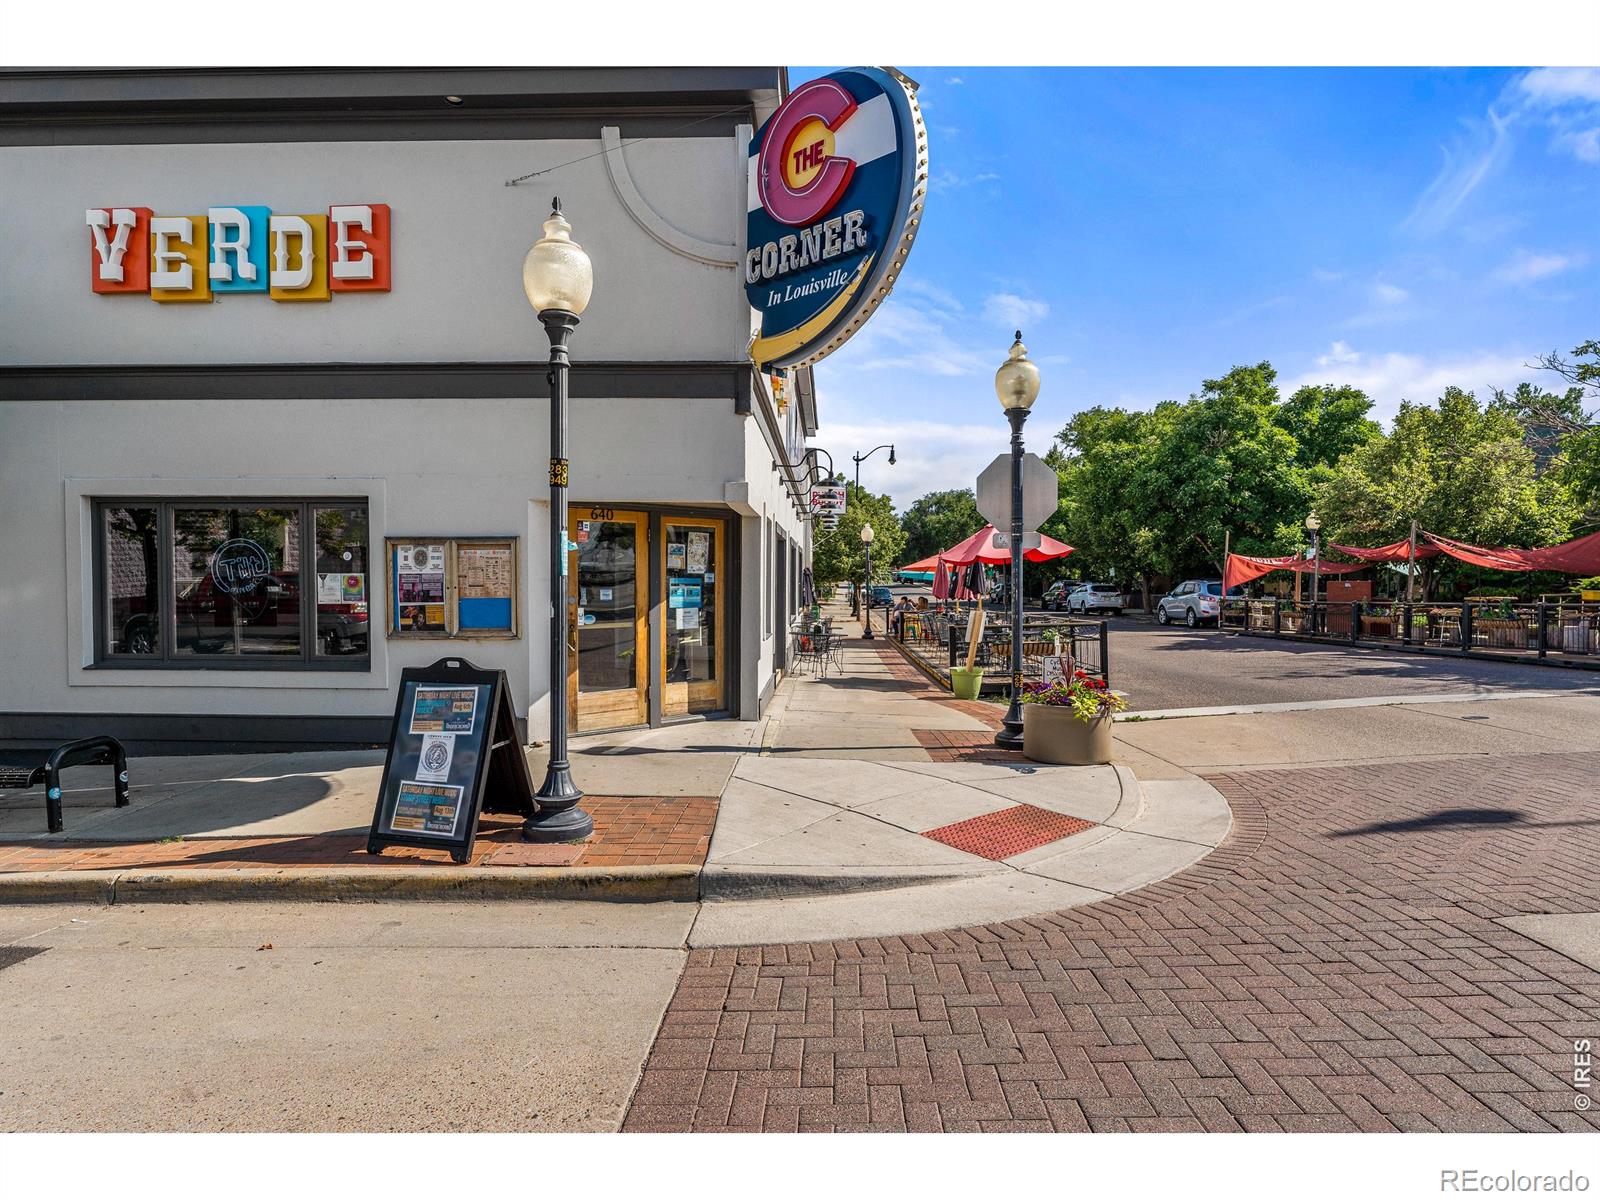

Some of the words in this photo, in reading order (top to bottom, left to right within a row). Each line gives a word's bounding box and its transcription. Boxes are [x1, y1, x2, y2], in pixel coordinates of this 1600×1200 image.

[793, 139, 826, 174] THE
[86, 205, 374, 290] VERDE
[745, 209, 869, 285] CORNER
[767, 290, 781, 307] In
[784, 268, 848, 302] Louisville
[591, 509, 614, 521] 640
[219, 556, 262, 582] Tilt
[451, 691, 462, 699] LIVE
[454, 703, 463, 711] Aug
[435, 806, 444, 815] Aug
